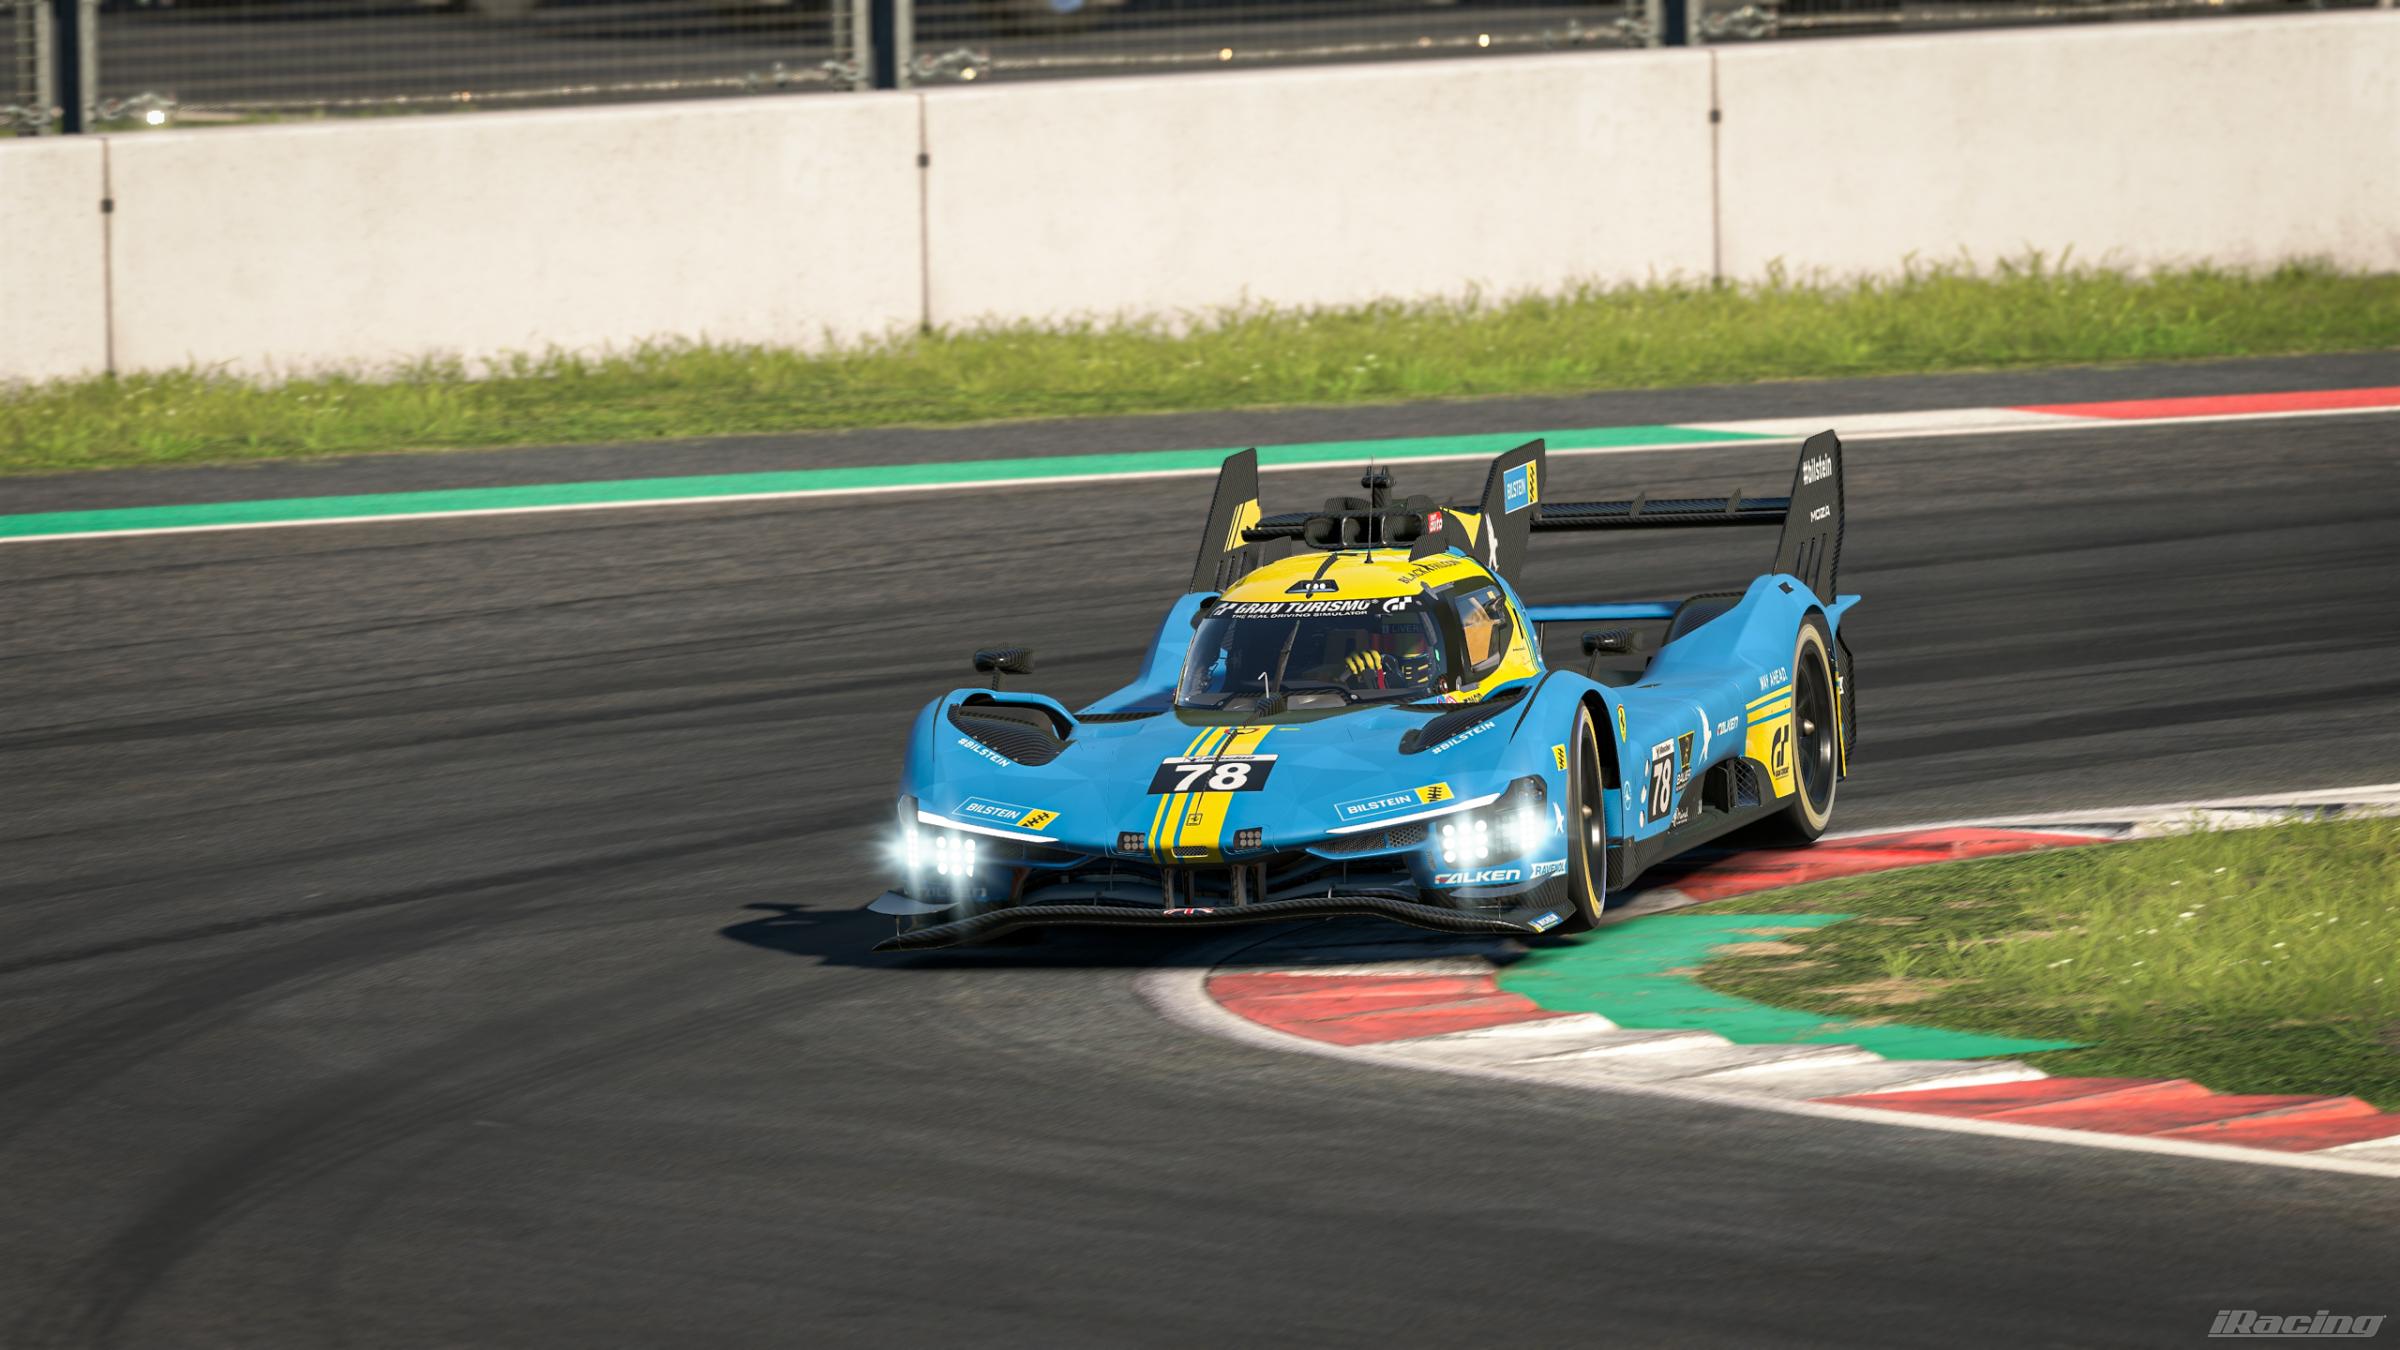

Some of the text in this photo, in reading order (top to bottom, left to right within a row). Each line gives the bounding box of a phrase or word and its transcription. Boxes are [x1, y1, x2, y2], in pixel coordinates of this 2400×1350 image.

[1803, 453, 1832, 485] #bilstein
[1507, 478, 1525, 500] BILSTEIN
[1810, 504, 1830, 523] MOZA
[1235, 599, 1370, 614] GRAN TURISMO
[1432, 721, 1496, 754] #BILSTEIN
[958, 738, 1010, 768] #BILSTEIN
[1174, 762, 1252, 791] 78
[1652, 758, 1672, 817] 78
[966, 803, 1021, 819] BILSTEIN
[1347, 795, 1412, 814] BILSTEIN
[1434, 869, 1521, 885] FALKEN
